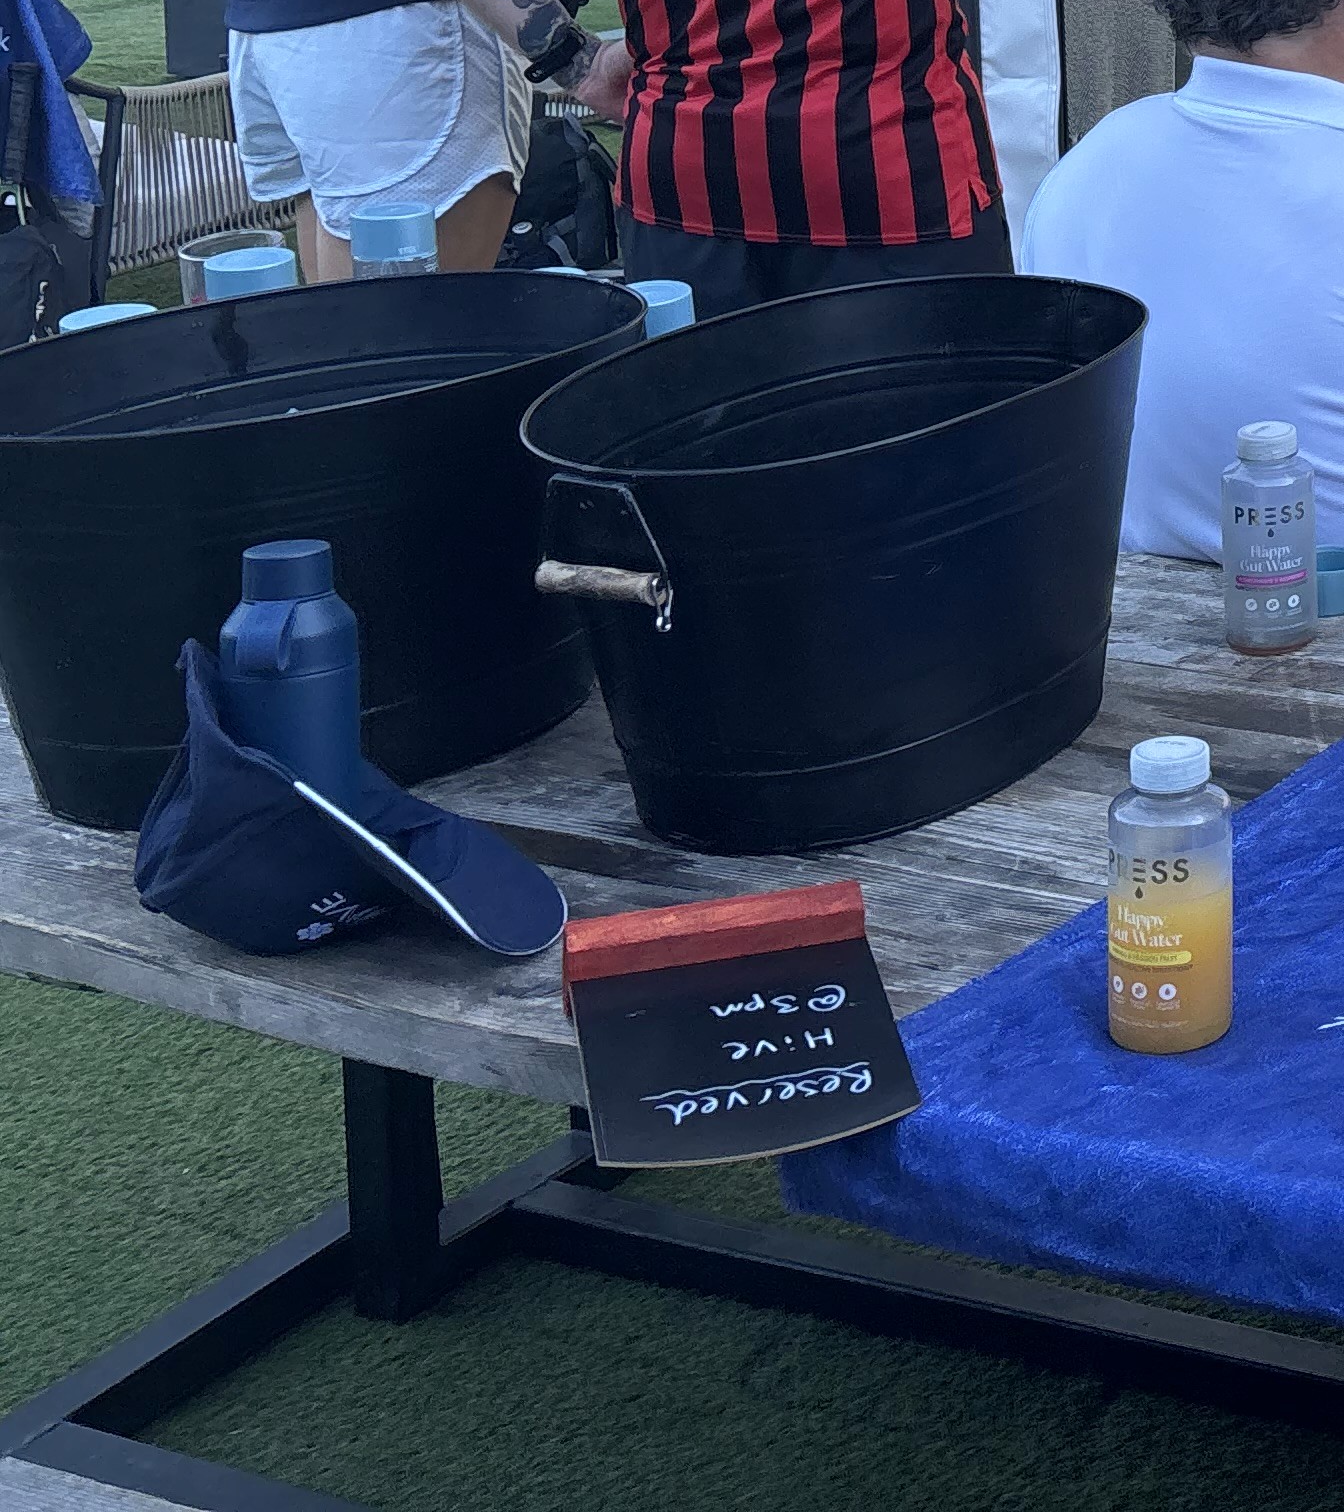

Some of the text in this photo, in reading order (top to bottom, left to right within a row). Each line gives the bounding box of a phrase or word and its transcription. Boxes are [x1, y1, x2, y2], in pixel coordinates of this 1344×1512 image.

[1234, 501, 1305, 526] PRESS
[1133, 930, 1183, 948] Water
[653, 1068, 873, 1126] Reserved
